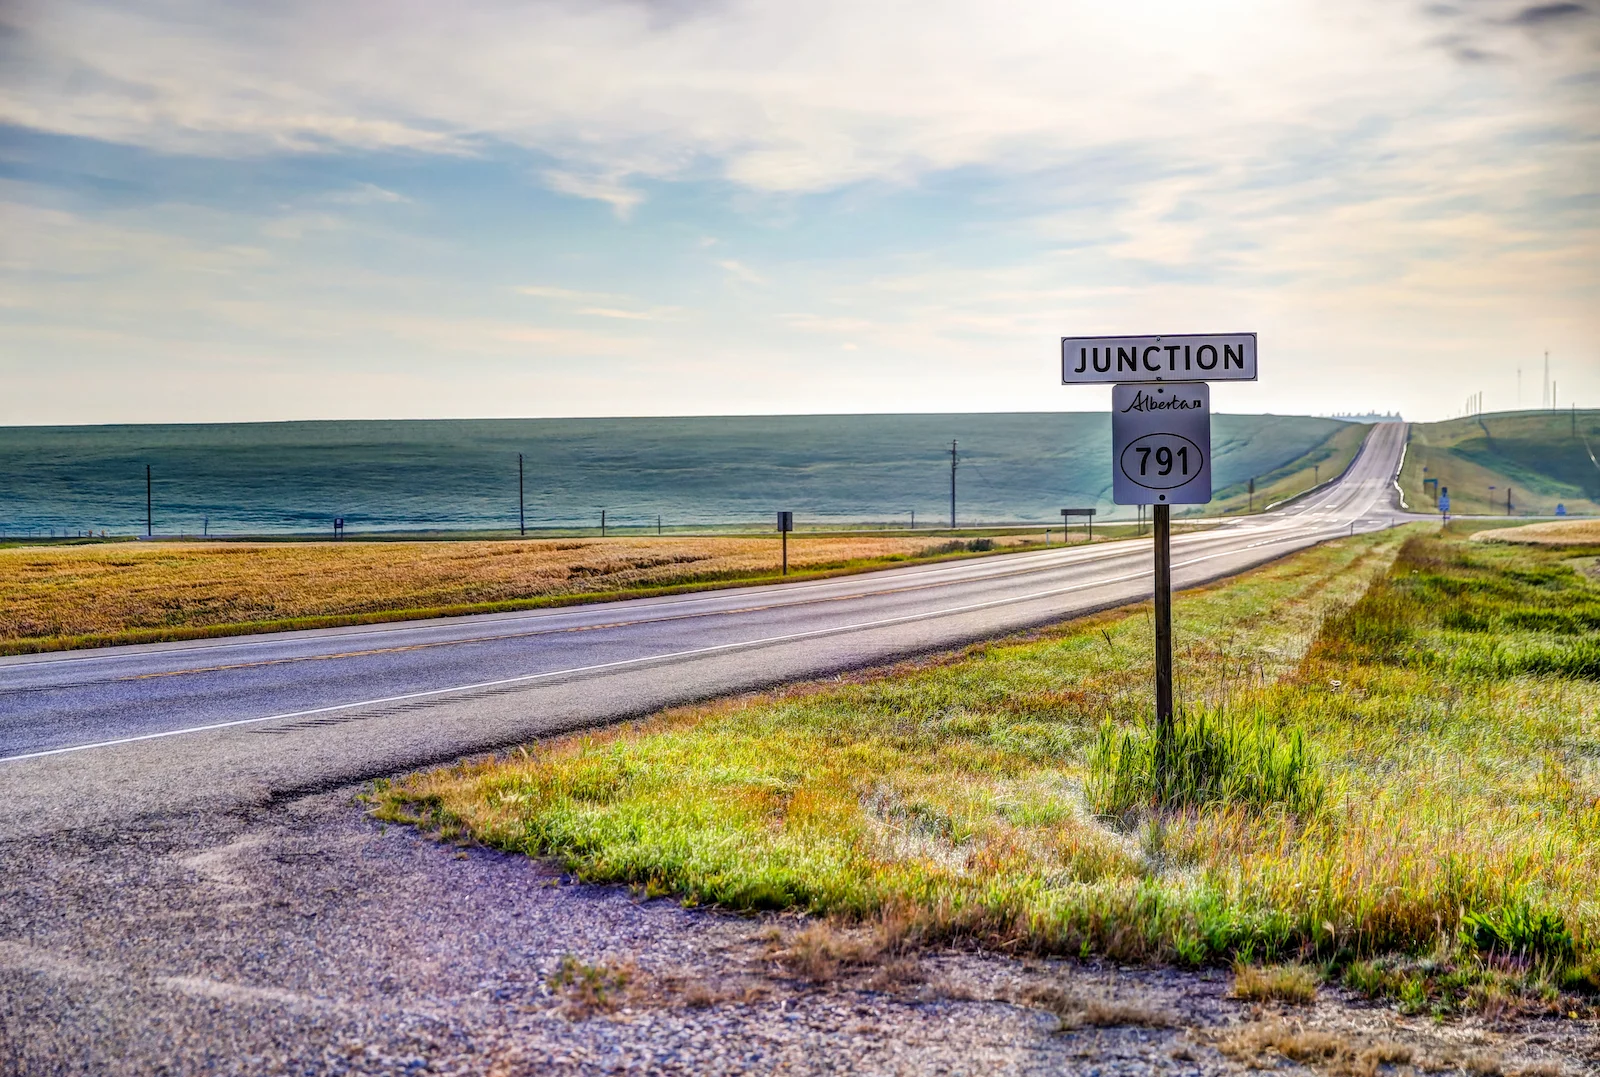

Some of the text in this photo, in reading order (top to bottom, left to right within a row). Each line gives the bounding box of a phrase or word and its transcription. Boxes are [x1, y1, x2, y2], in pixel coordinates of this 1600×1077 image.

[1074, 344, 1244, 373] JUNCTION
[1121, 390, 1194, 412] Alberta
[1135, 446, 1188, 476] 791
